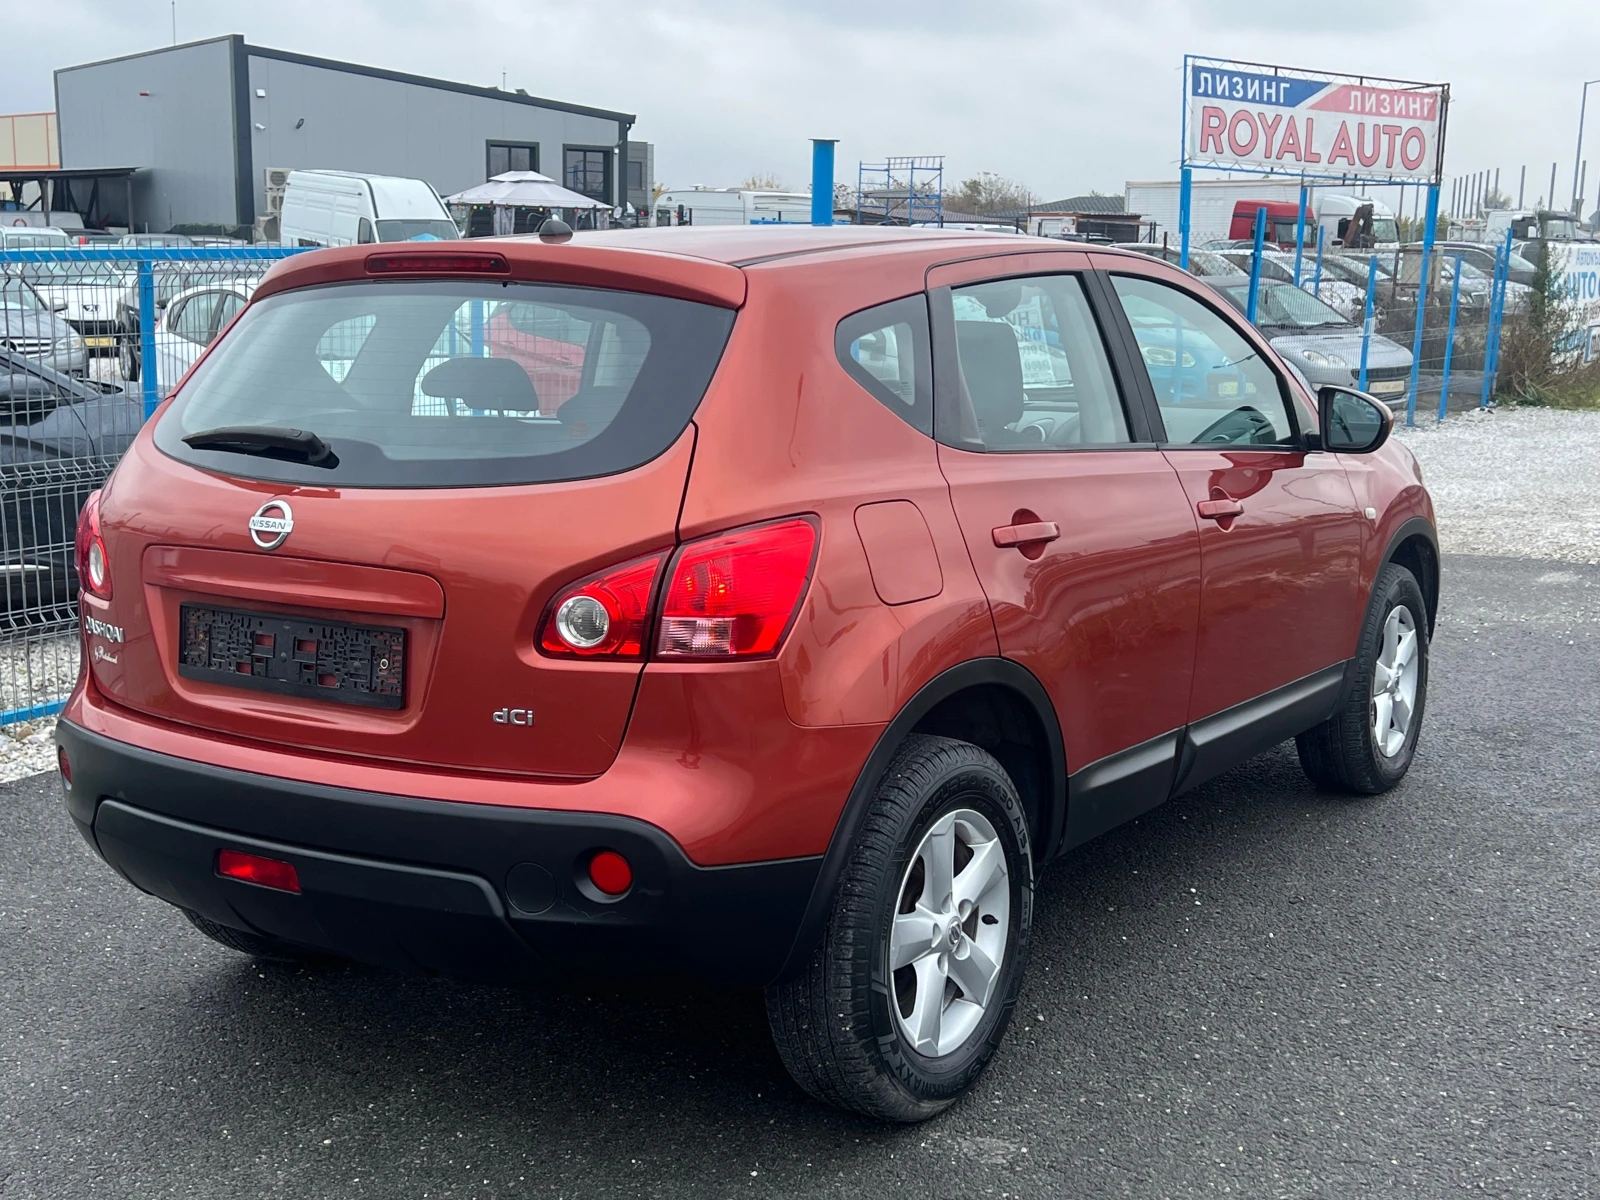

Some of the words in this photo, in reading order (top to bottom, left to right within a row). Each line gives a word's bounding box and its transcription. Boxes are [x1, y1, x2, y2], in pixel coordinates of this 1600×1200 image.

[1197, 72, 1291, 104] ЛИЗИНГ
[1348, 90, 1436, 118] ЛИЗИНГ
[1200, 105, 1322, 163] ROYAL
[1328, 120, 1426, 171] AUTO
[250, 519, 287, 530] NISSAN
[85, 615, 125, 644] QASHQAI
[492, 707, 533, 727] dCi
